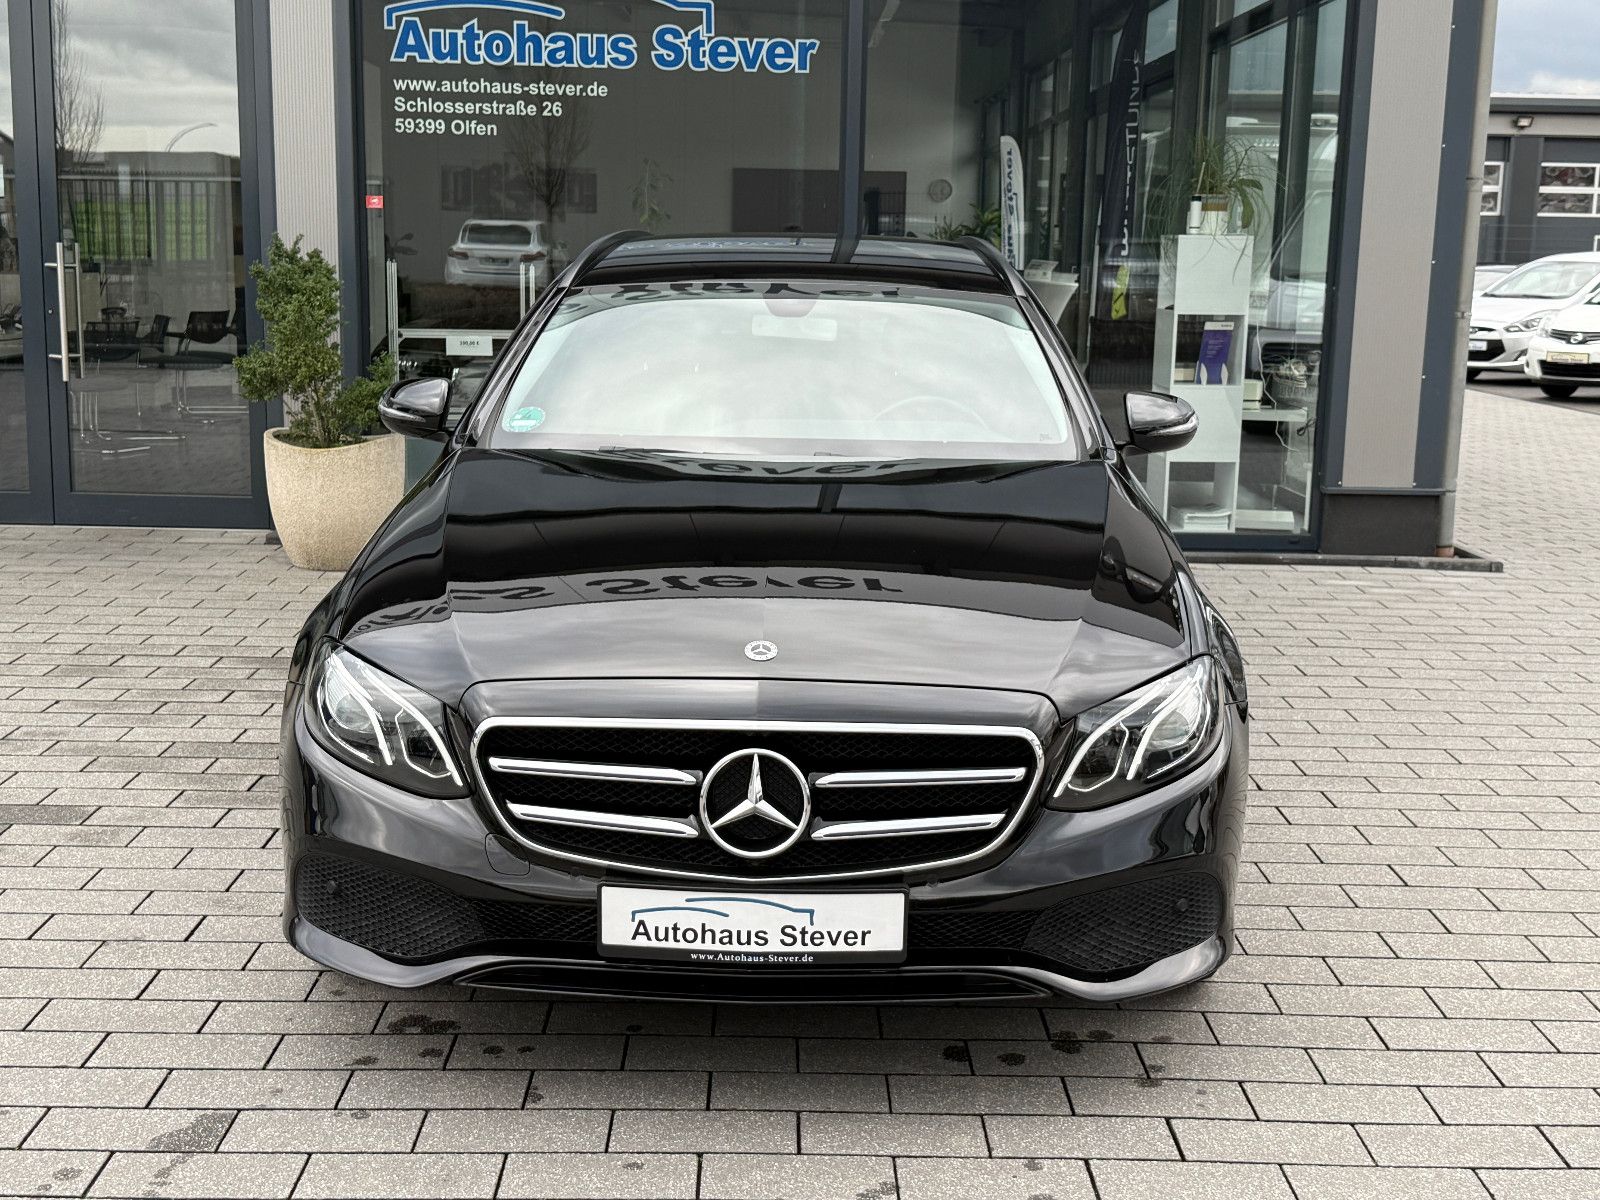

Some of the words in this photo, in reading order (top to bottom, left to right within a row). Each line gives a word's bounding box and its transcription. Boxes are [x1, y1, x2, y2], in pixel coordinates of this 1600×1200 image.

[390, 17, 638, 70] Autohaus
[651, 24, 820, 73] Stever
[393, 78, 608, 97] www.autohaus-stever.de
[394, 97, 537, 116] Schlosserstraße
[542, 101, 563, 117] 26
[394, 118, 446, 134] 59399
[451, 119, 498, 136] Olfen
[631, 919, 769, 946] Autohaus
[779, 924, 872, 947] Stever
[690, 951, 814, 963] www.Autohaus-Stever.de
